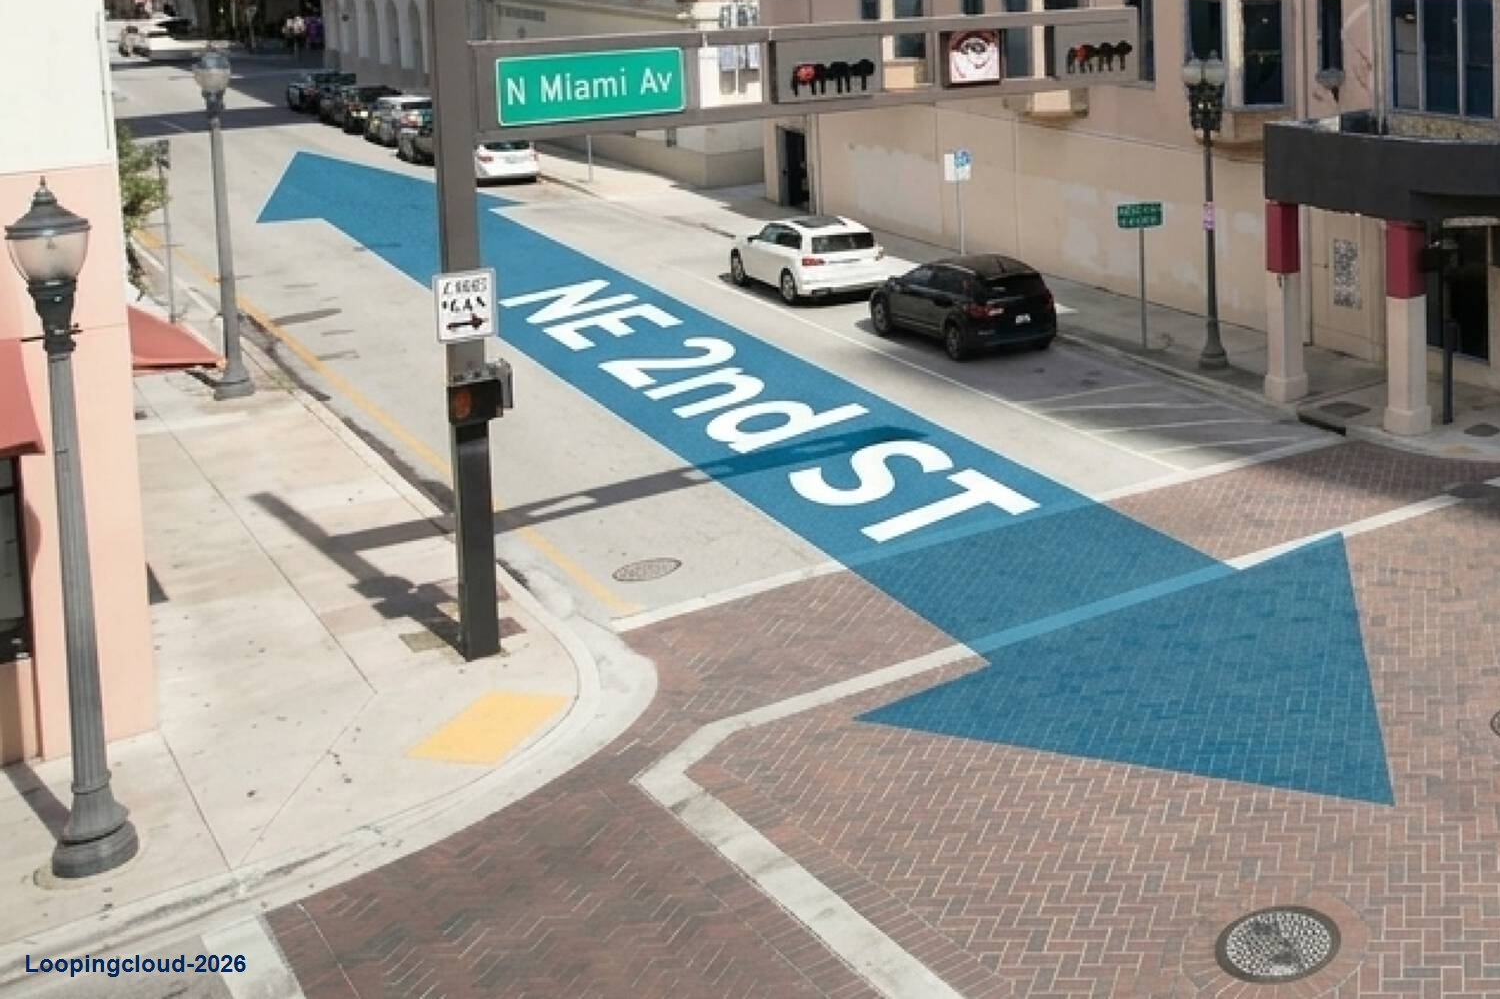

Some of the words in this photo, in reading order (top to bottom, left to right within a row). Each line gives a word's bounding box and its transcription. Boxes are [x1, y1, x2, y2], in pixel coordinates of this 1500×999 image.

[506, 76, 526, 106] N
[540, 66, 628, 103] Miami
[639, 67, 673, 95] Av
